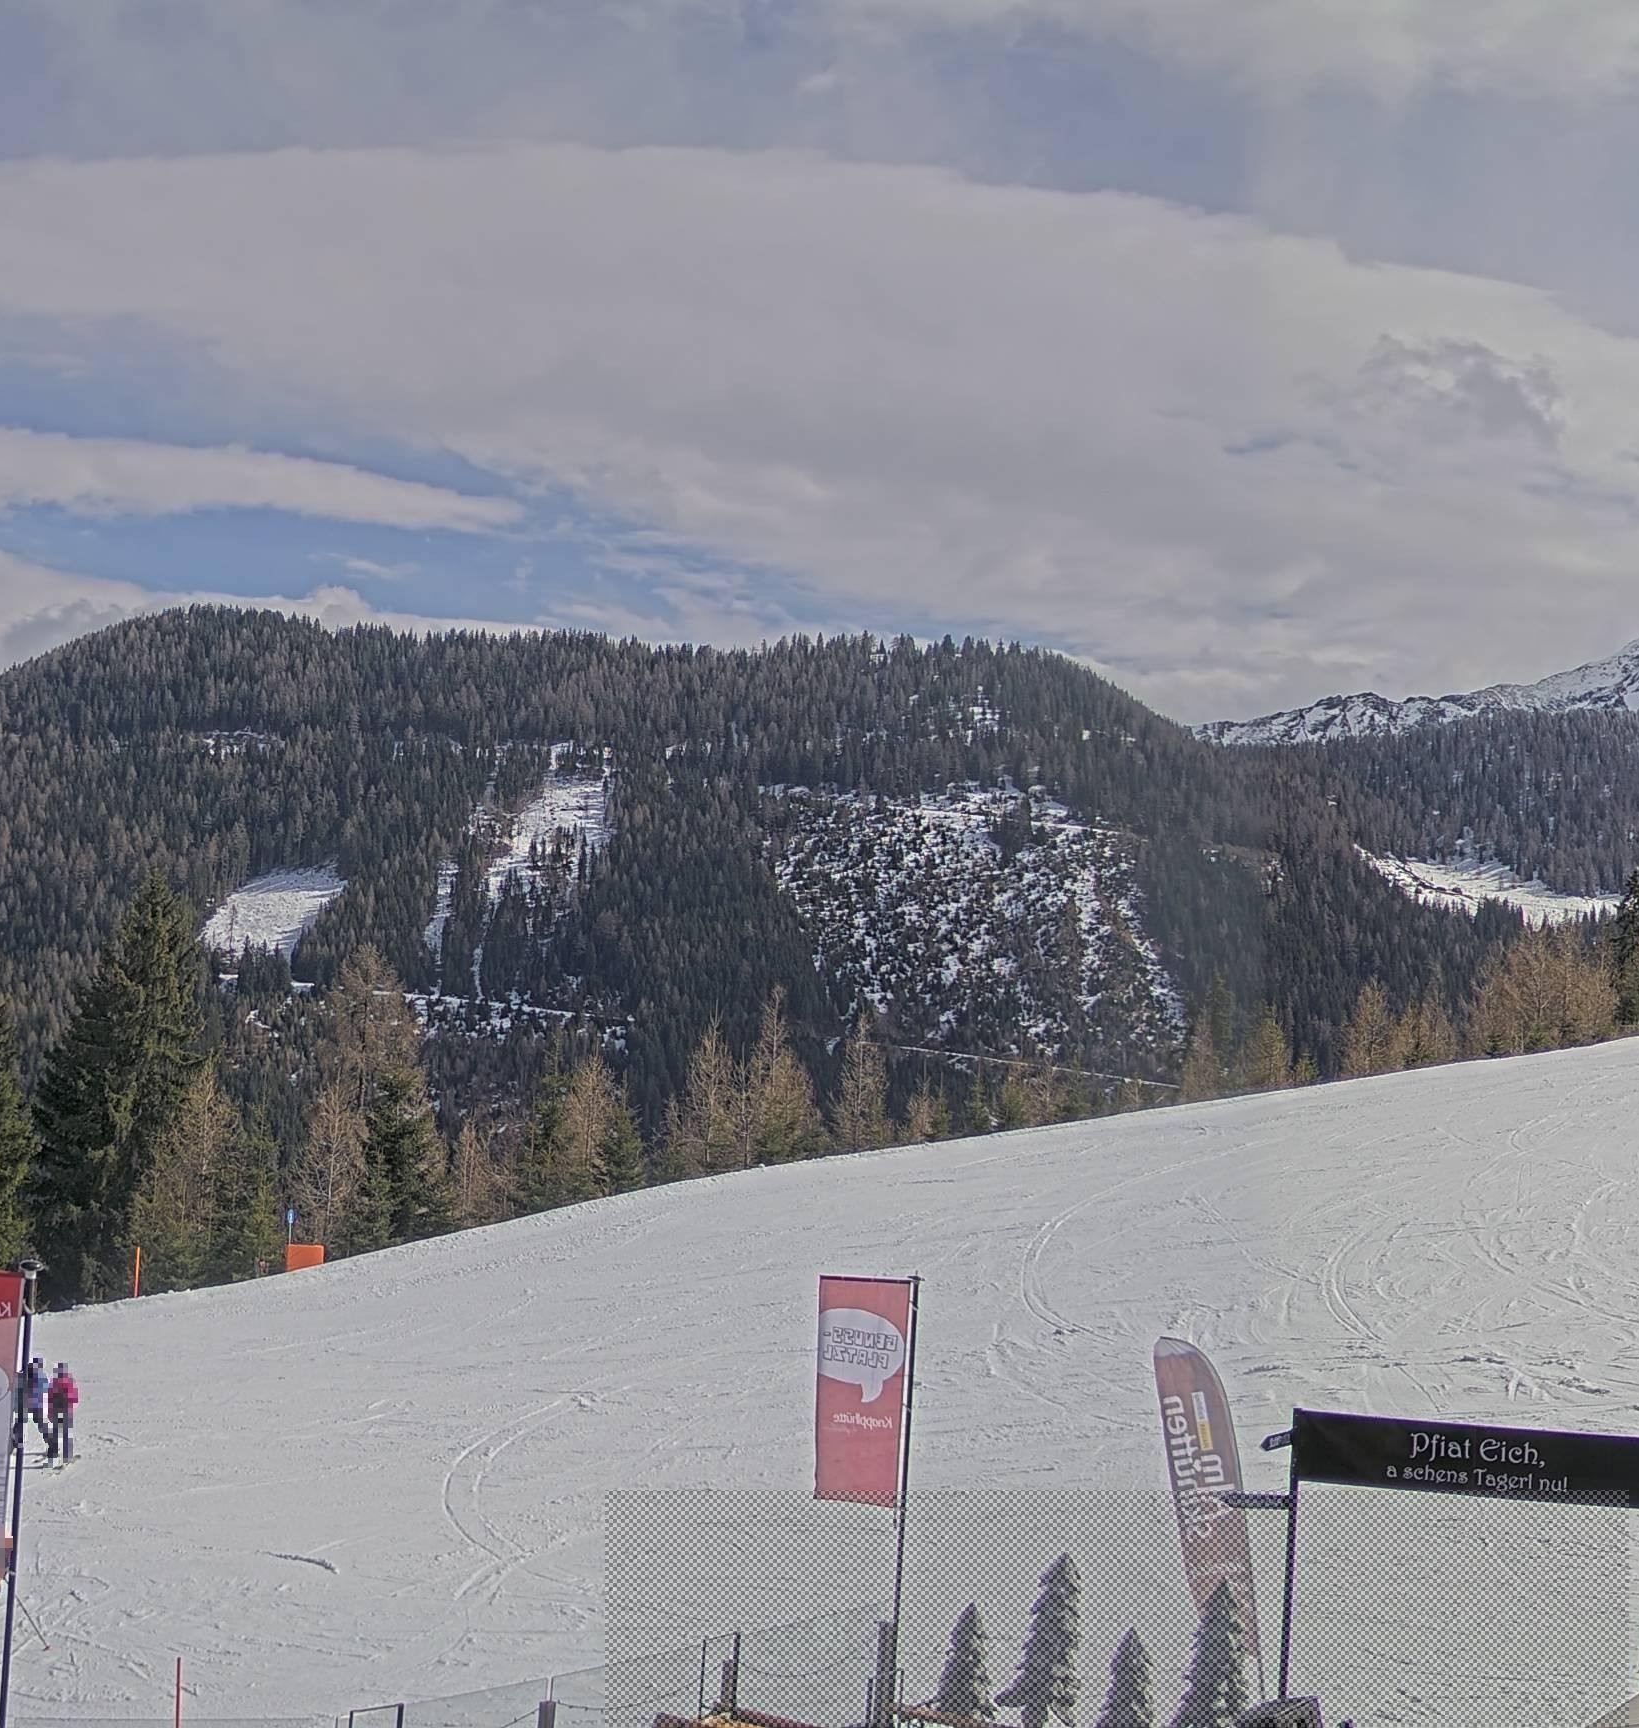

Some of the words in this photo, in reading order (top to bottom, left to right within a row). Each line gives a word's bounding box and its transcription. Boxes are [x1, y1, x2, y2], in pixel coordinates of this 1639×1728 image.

[1409, 1433, 1471, 1461] Pfiat
[1479, 1439, 1545, 1468] Eich,
[1386, 1465, 1398, 1478] a
[1402, 1464, 1469, 1484] schens
[1473, 1469, 1533, 1492] Tagerl
[1539, 1476, 1568, 1492] nu!
